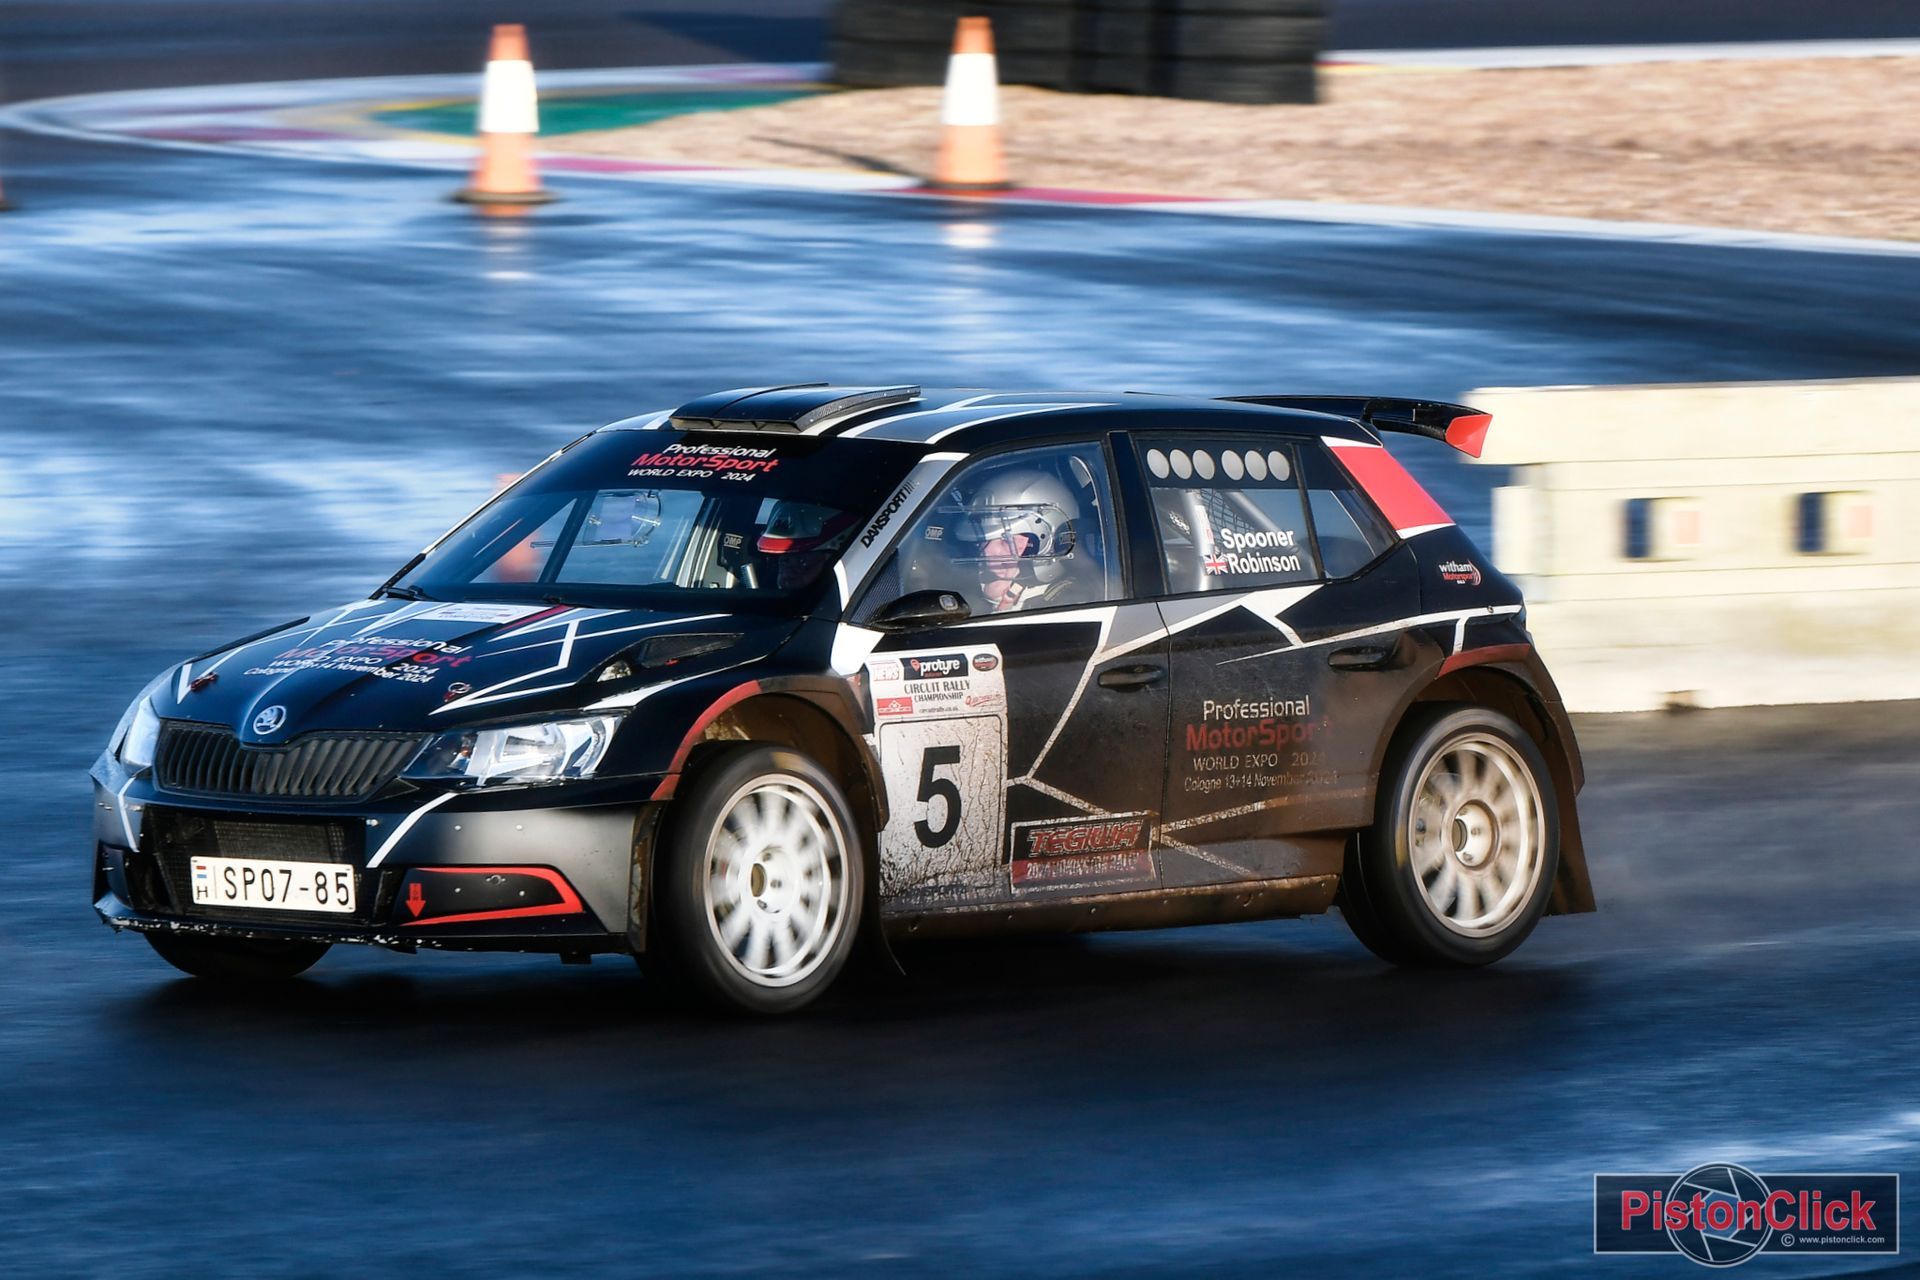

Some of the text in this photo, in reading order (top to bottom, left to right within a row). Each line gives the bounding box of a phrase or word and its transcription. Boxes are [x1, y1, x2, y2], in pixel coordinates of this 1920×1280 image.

[662, 443, 777, 458] Professional
[630, 453, 780, 472] MotorSport
[627, 468, 756, 482] WORLD EXPO 2024
[861, 487, 909, 549] DANSPORT
[724, 534, 742, 548] OMP
[924, 527, 944, 540] OMP
[1220, 528, 1295, 552] Spooner
[1227, 552, 1301, 574] Robinson
[1439, 561, 1472, 573] witham
[337, 656, 382, 665] EXPO
[392, 662, 439, 674] 2024
[921, 659, 960, 677] protyre
[399, 672, 434, 684] 2024
[904, 680, 970, 694] CIRCUIT RALLY
[914, 691, 963, 703] CHAMPIONSHIP
[1203, 695, 1310, 720] Professional
[1193, 756, 1239, 772] WORLD
[1244, 753, 1278, 768] EXPO
[1184, 776, 1222, 793] Cologne
[913, 745, 962, 848] 5
[224, 866, 350, 906] SP07-85
